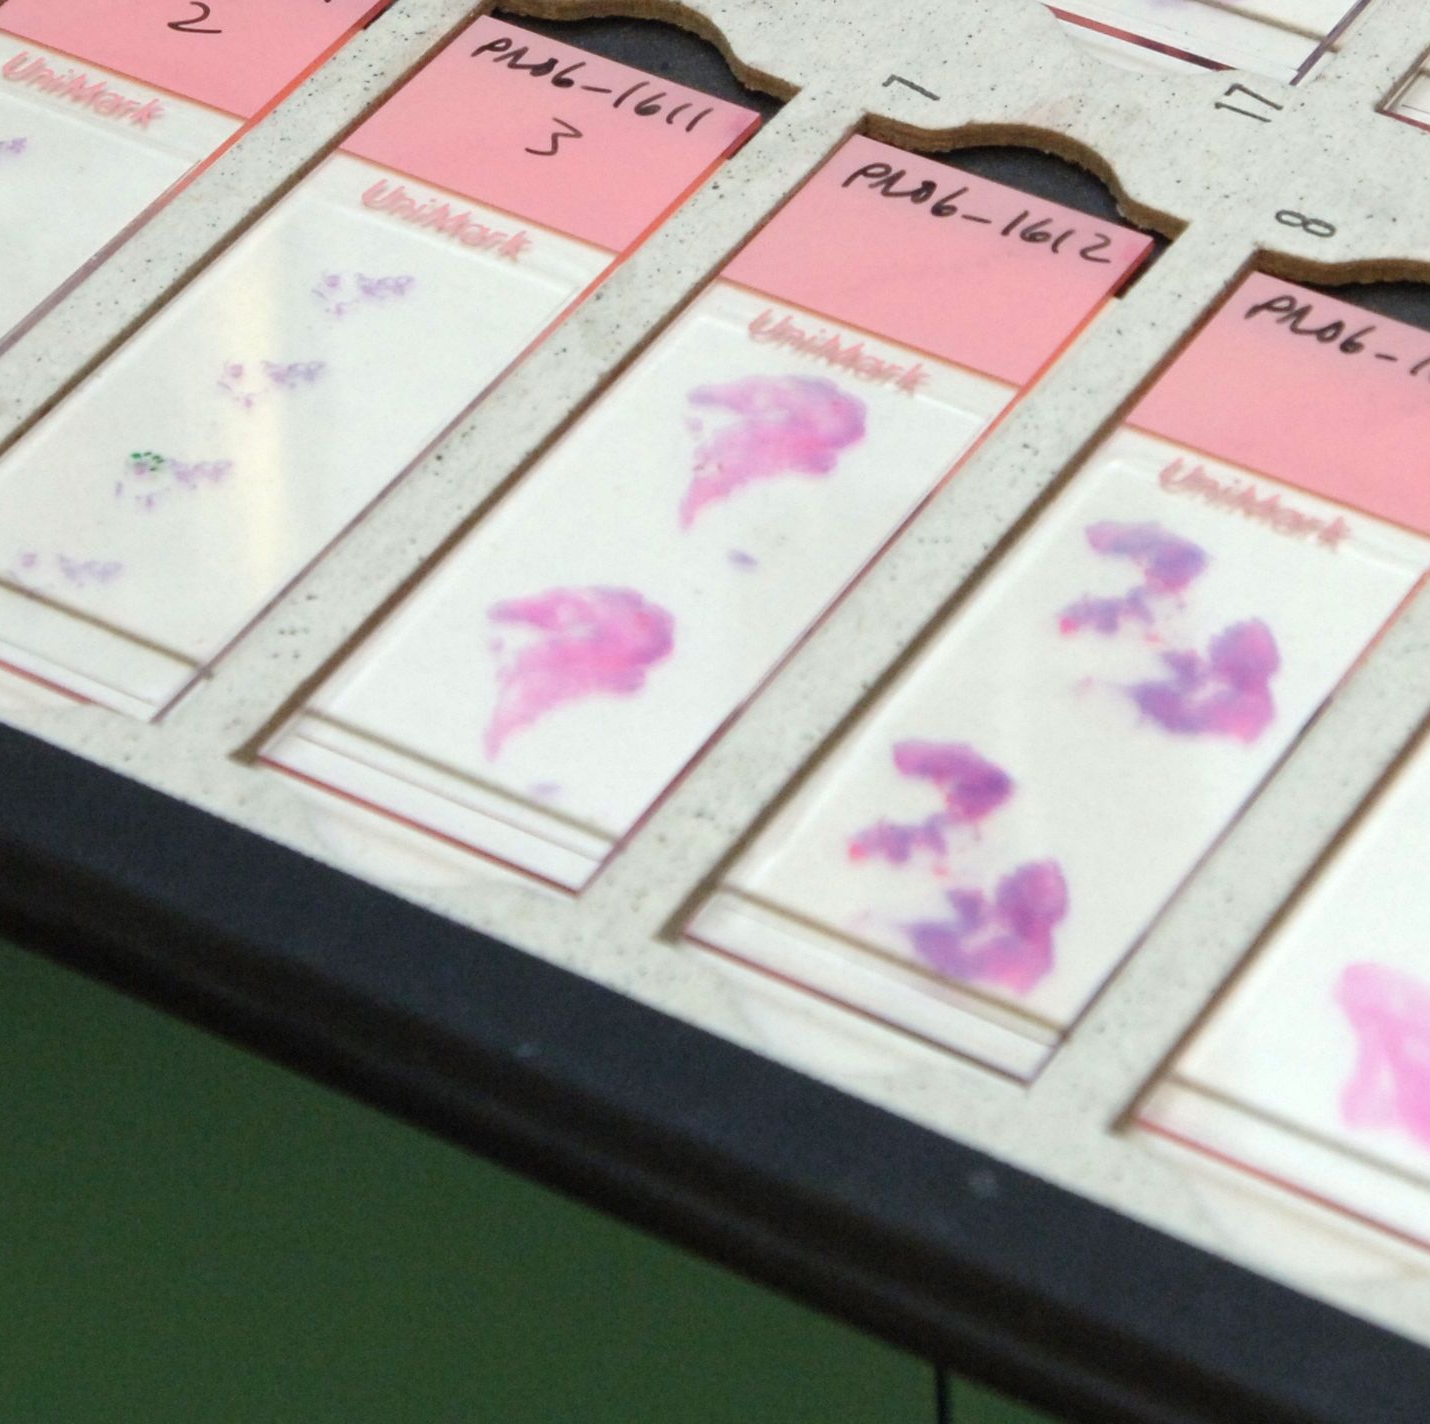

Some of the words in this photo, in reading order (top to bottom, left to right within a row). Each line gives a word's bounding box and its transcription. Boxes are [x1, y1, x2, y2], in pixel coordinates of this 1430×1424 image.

[166, 0, 223, 35] 2
[2, 49, 169, 131] UniMark
[881, 73, 941, 102] 7
[1214, 82, 1284, 123] 17
[524, 117, 584, 157] 3
[361, 177, 533, 262] UniMark
[1274, 208, 1337, 239] 8
[747, 308, 935, 400] UniMark
[1157, 455, 1356, 554] UniMark
